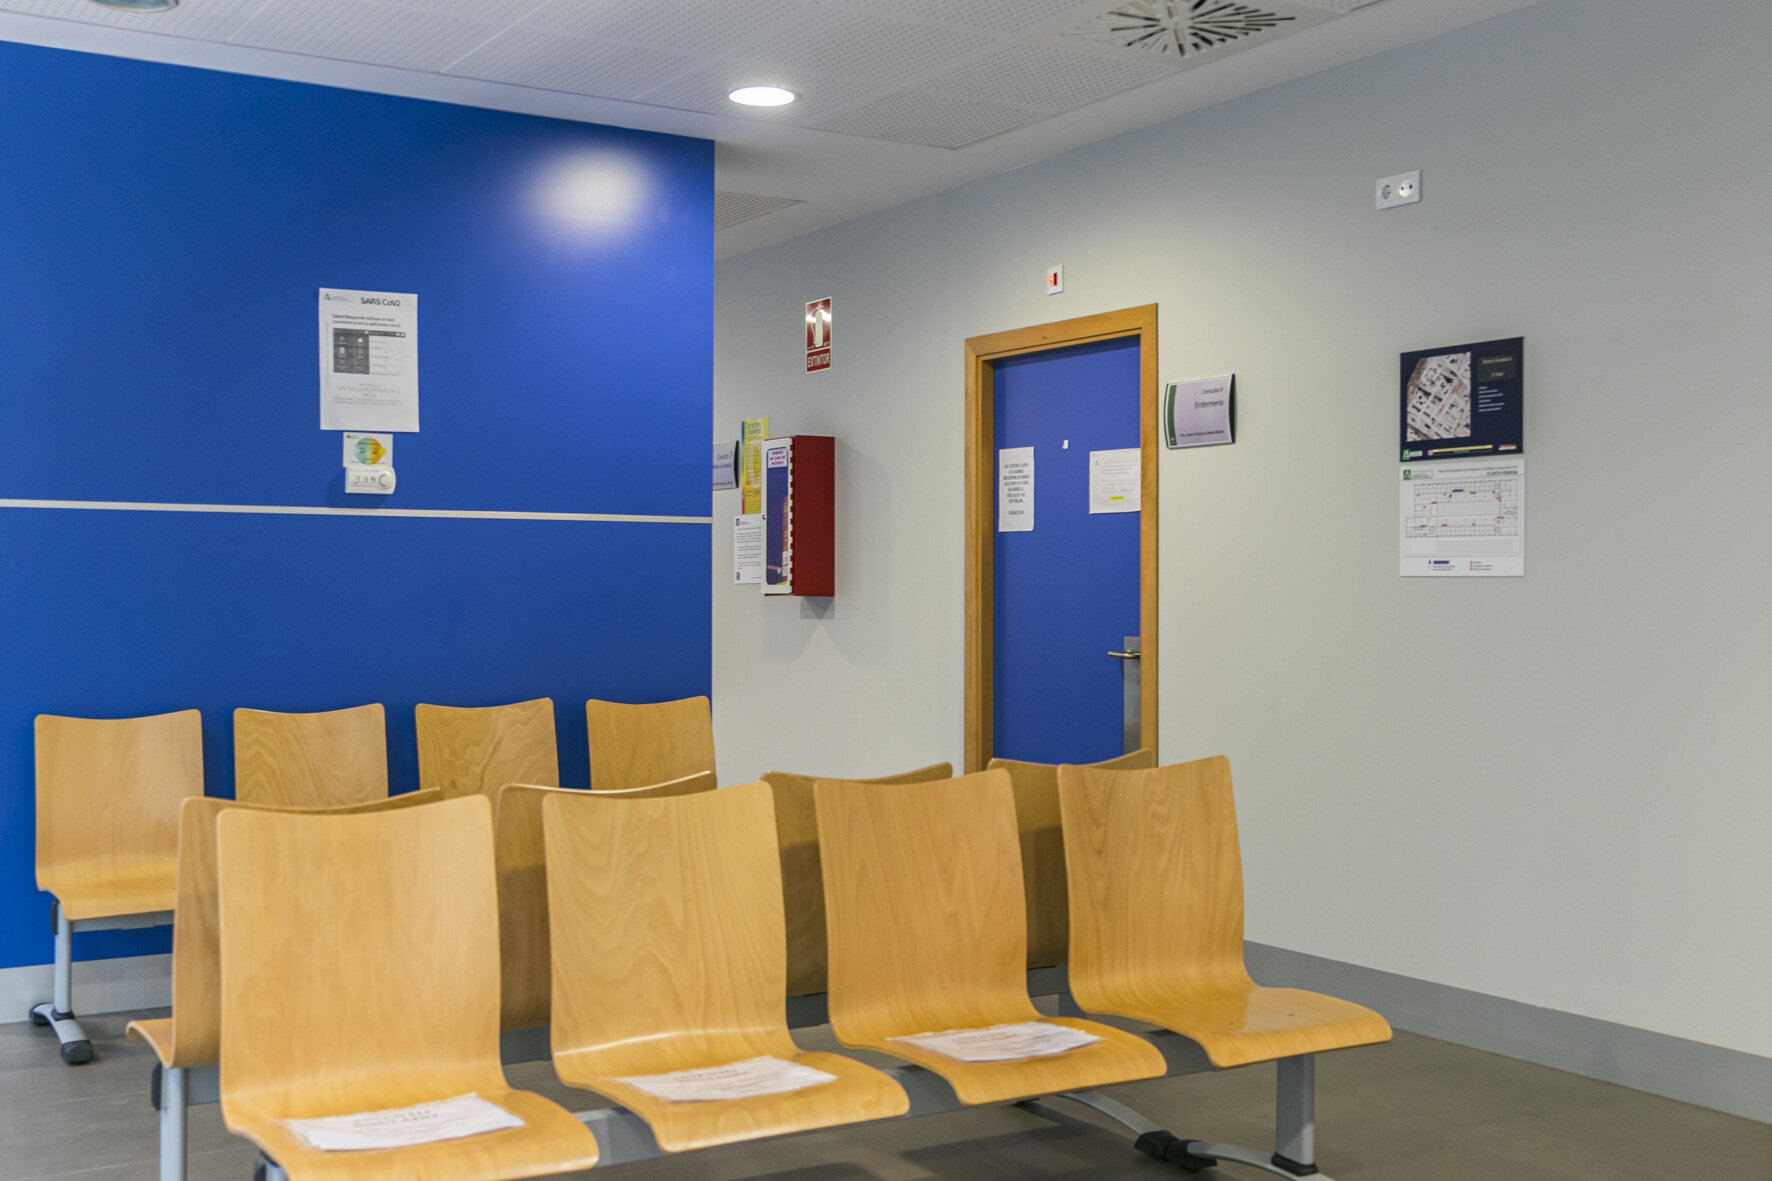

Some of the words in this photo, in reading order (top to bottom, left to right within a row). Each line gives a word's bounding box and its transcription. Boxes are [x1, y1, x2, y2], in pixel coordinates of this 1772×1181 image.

[360, 297, 380, 305] SARS
[808, 352, 830, 368] EXTINTOR
[1194, 399, 1224, 409] Enfermería
